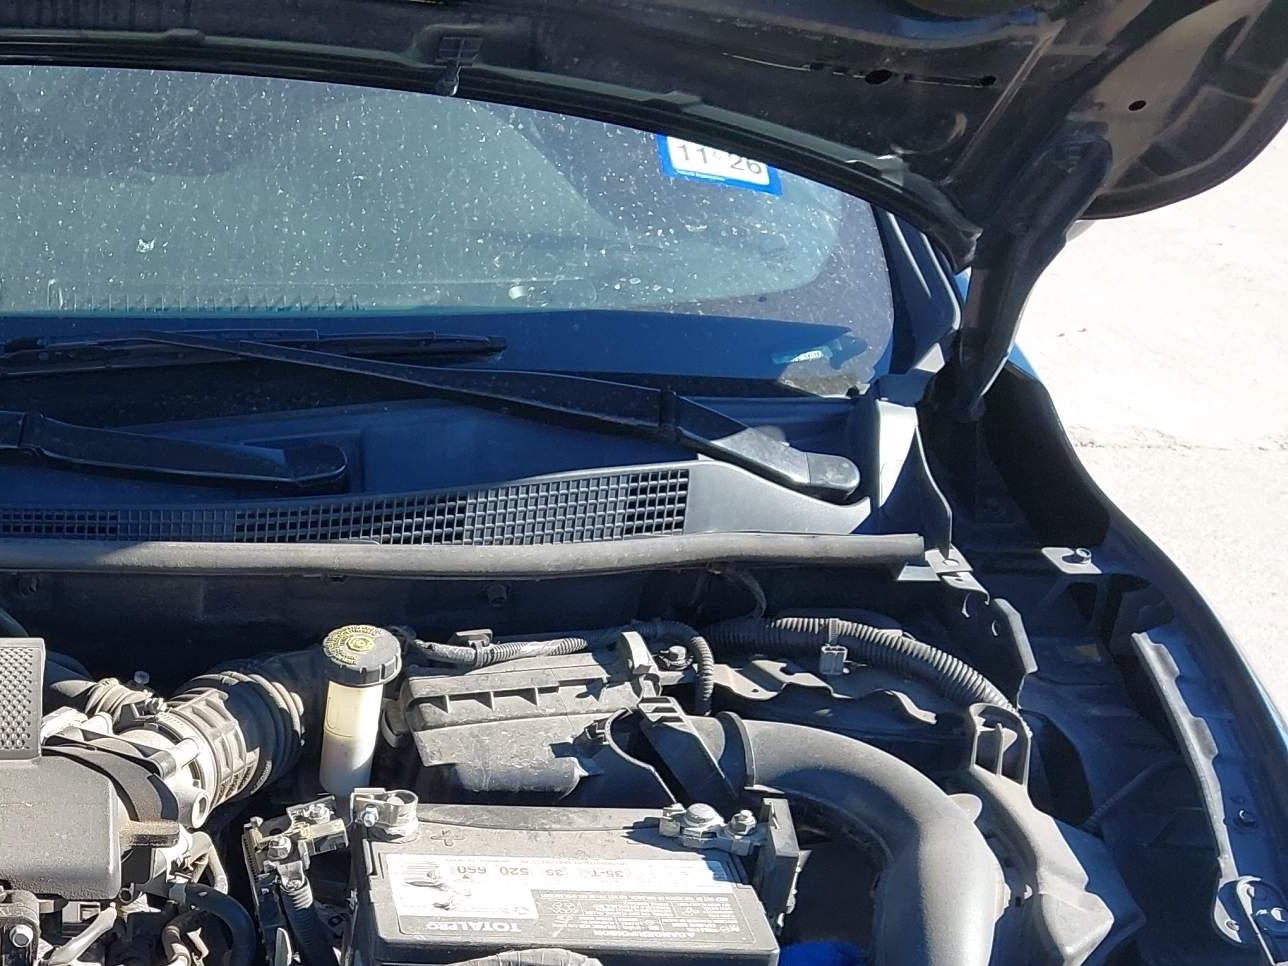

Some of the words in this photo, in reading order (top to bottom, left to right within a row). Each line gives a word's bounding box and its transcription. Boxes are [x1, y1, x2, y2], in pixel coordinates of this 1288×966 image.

[678, 144, 708, 164] 11
[731, 156, 763, 175] 26
[499, 866, 530, 876] 520
